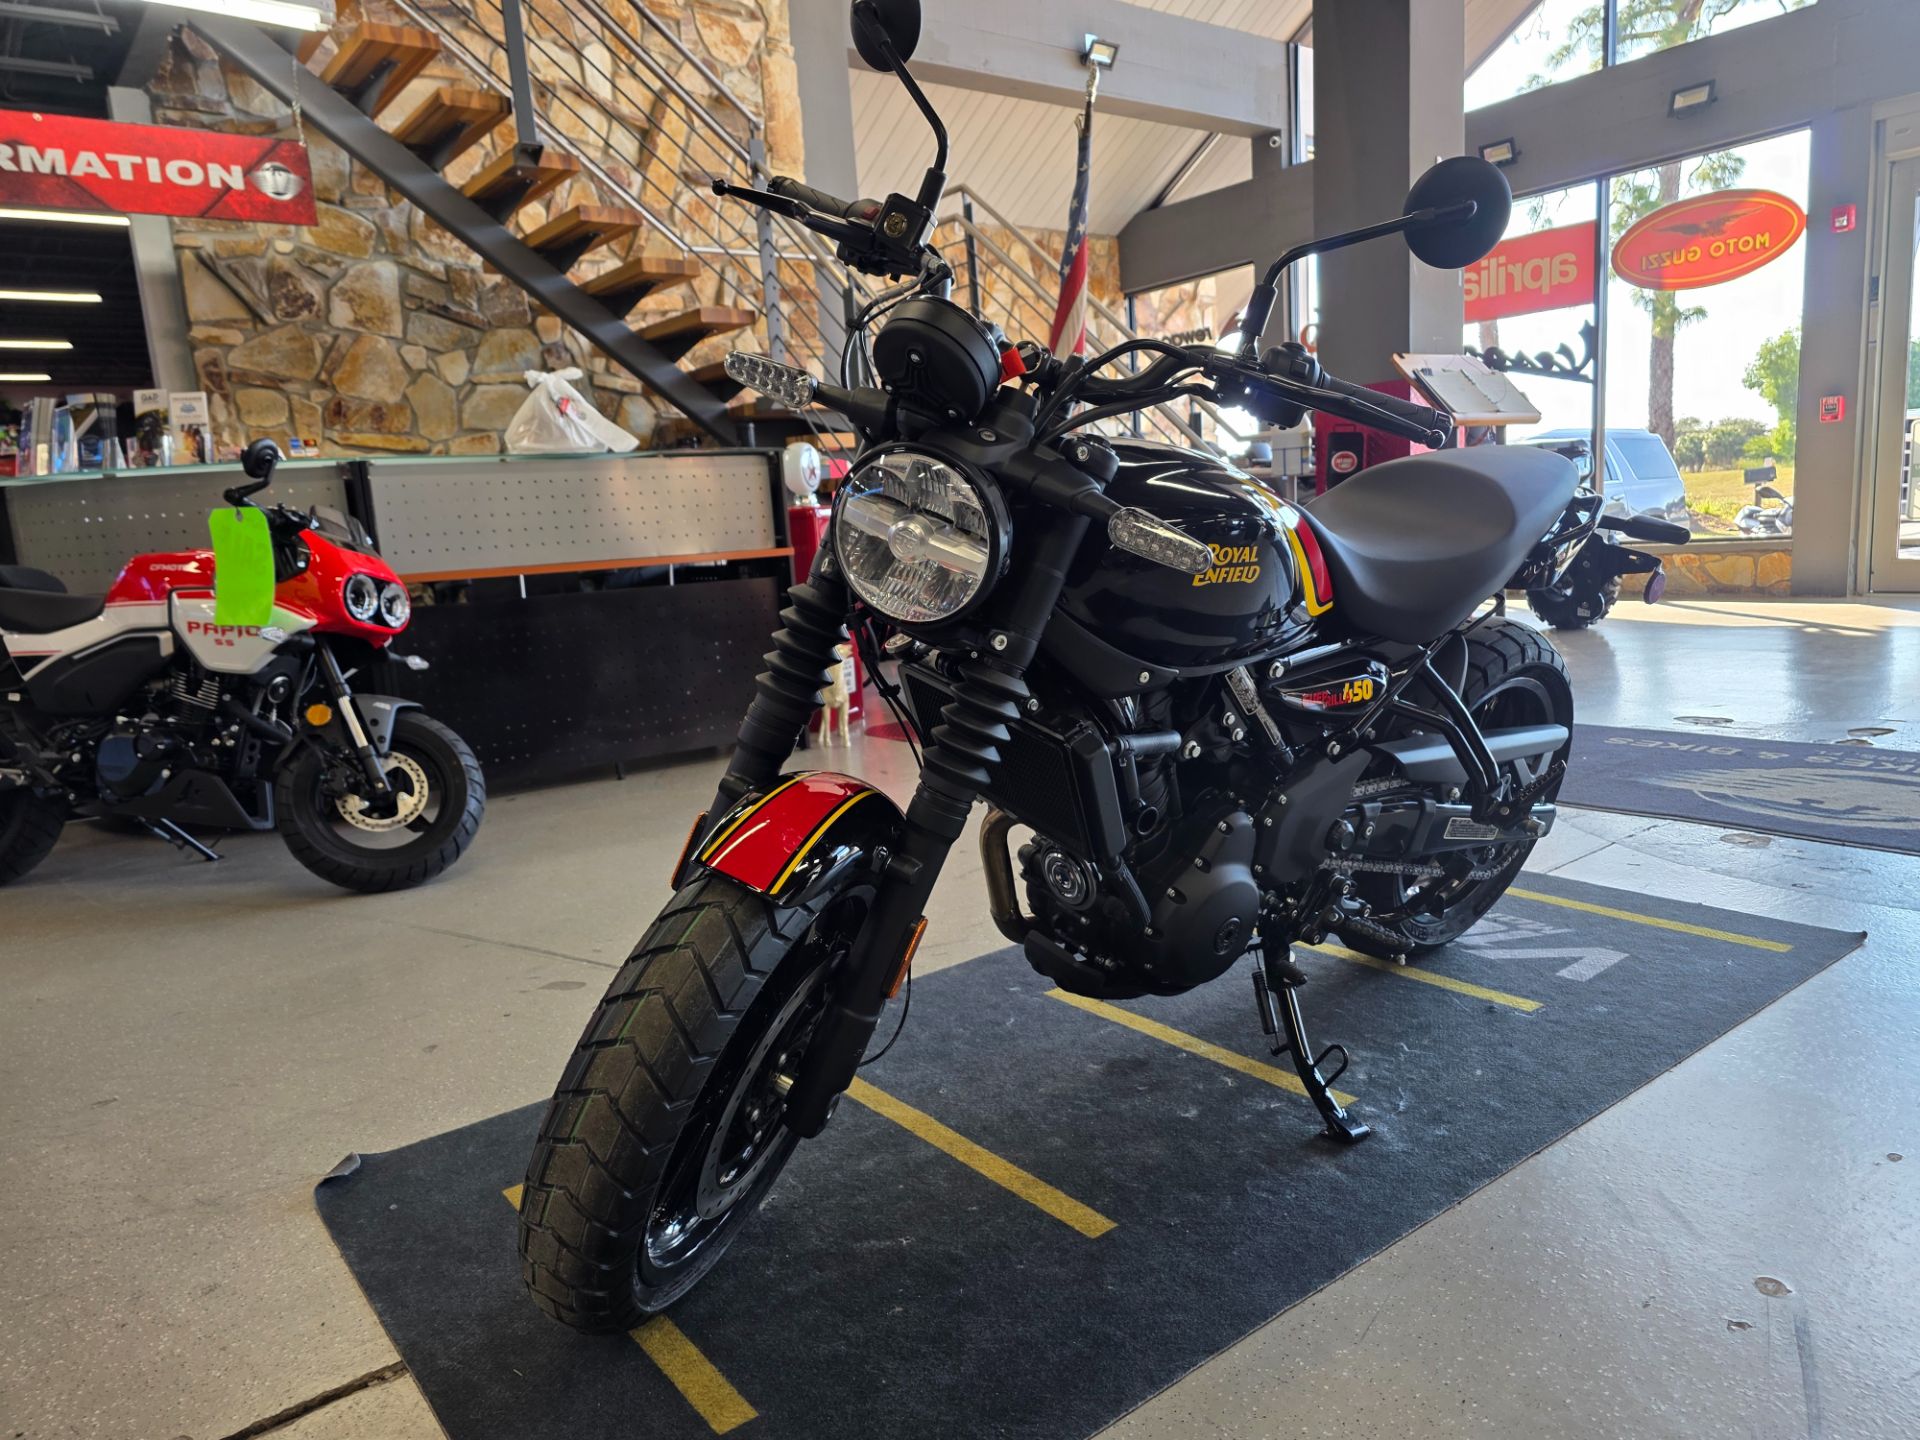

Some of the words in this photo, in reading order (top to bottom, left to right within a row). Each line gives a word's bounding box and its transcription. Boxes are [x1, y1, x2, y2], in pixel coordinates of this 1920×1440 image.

[1207, 543, 1258, 566] ROYAL
[1192, 565, 1260, 587] ENFIELD
[1342, 678, 1374, 703] 450
[1603, 736, 1743, 756] BIKES
[1758, 750, 1791, 760] &
